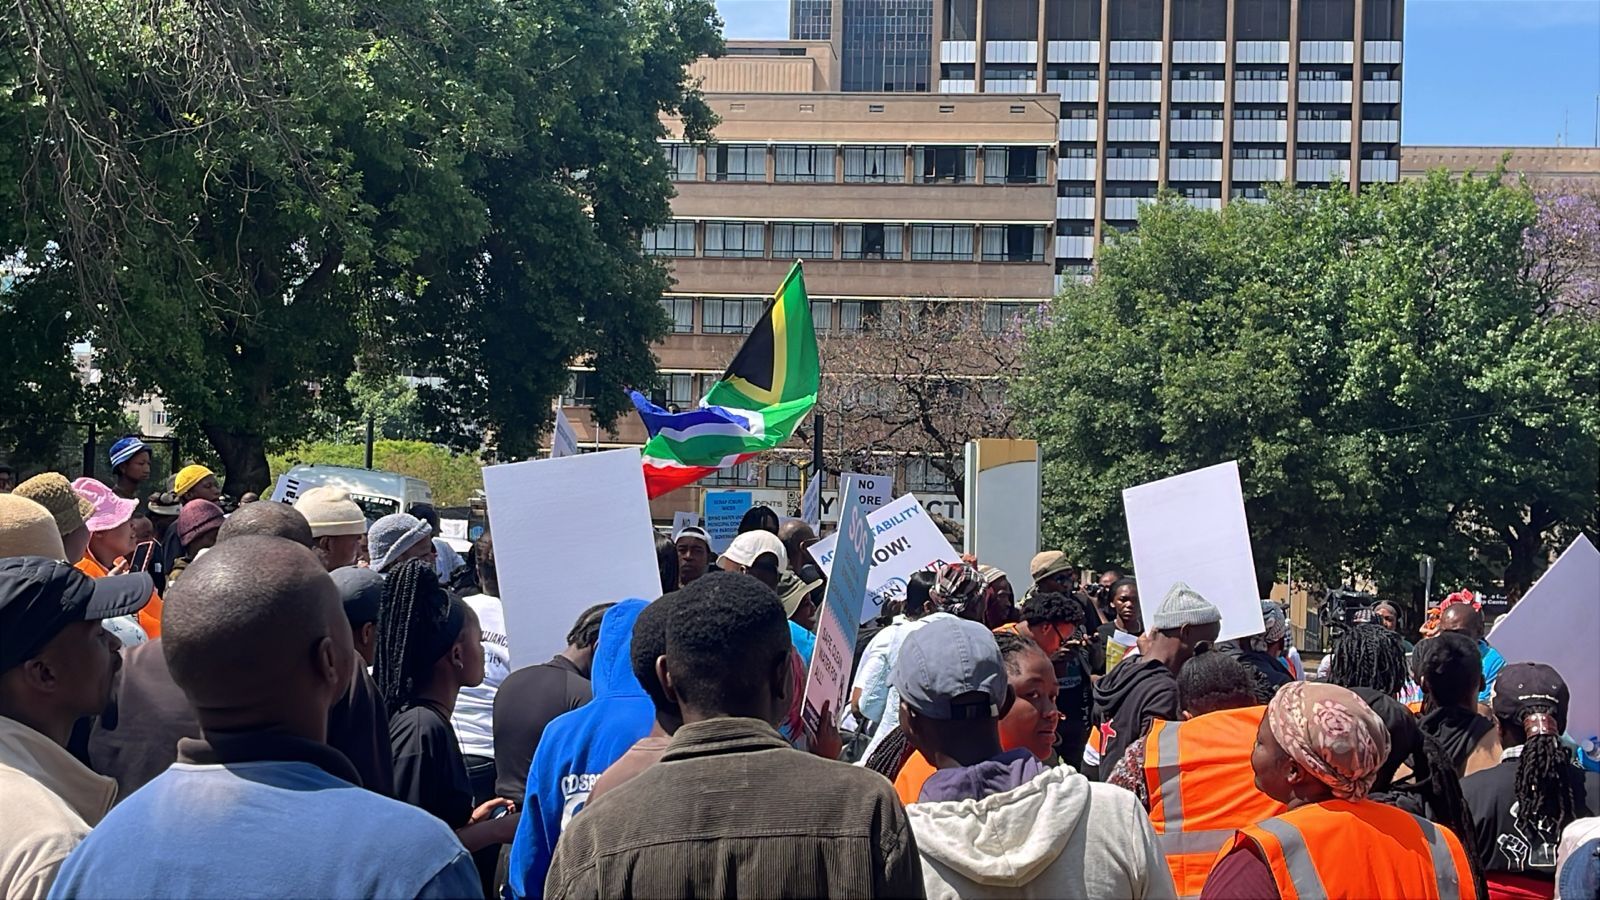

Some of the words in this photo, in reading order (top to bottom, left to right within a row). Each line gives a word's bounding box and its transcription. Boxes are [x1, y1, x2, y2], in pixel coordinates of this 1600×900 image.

[281, 479, 300, 506] Fall
[858, 479, 875, 490] NO
[858, 495, 882, 506] ORE
[848, 505, 868, 565] SOS
[872, 584, 903, 607] CAN
